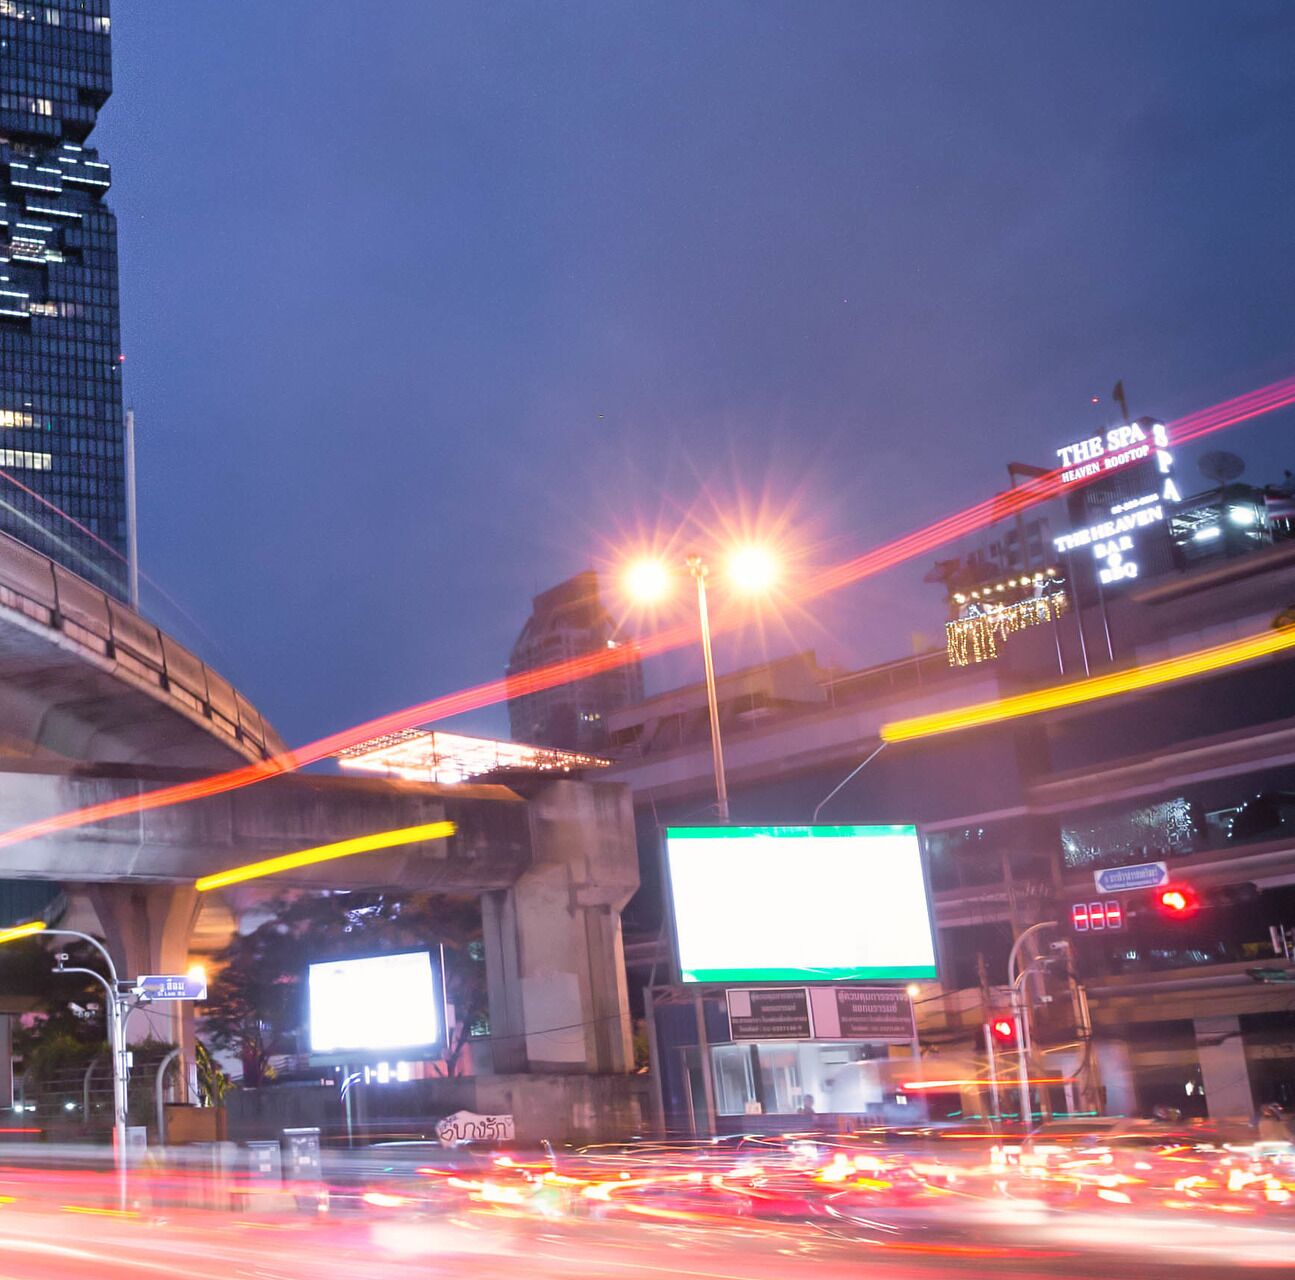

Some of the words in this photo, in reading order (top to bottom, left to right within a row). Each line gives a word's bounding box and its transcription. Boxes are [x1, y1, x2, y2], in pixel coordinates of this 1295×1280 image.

[1057, 436, 1104, 468] THE
[1106, 423, 1146, 452] SPA
[1062, 462, 1101, 483] HEAVEN
[1104, 445, 1150, 470] ROOFTOP
[1152, 424, 1182, 502] SPA
[1090, 505, 1164, 542] HEAVEN
[1093, 536, 1135, 559] BAR
[453, 1117, 506, 1140] บางรัก
